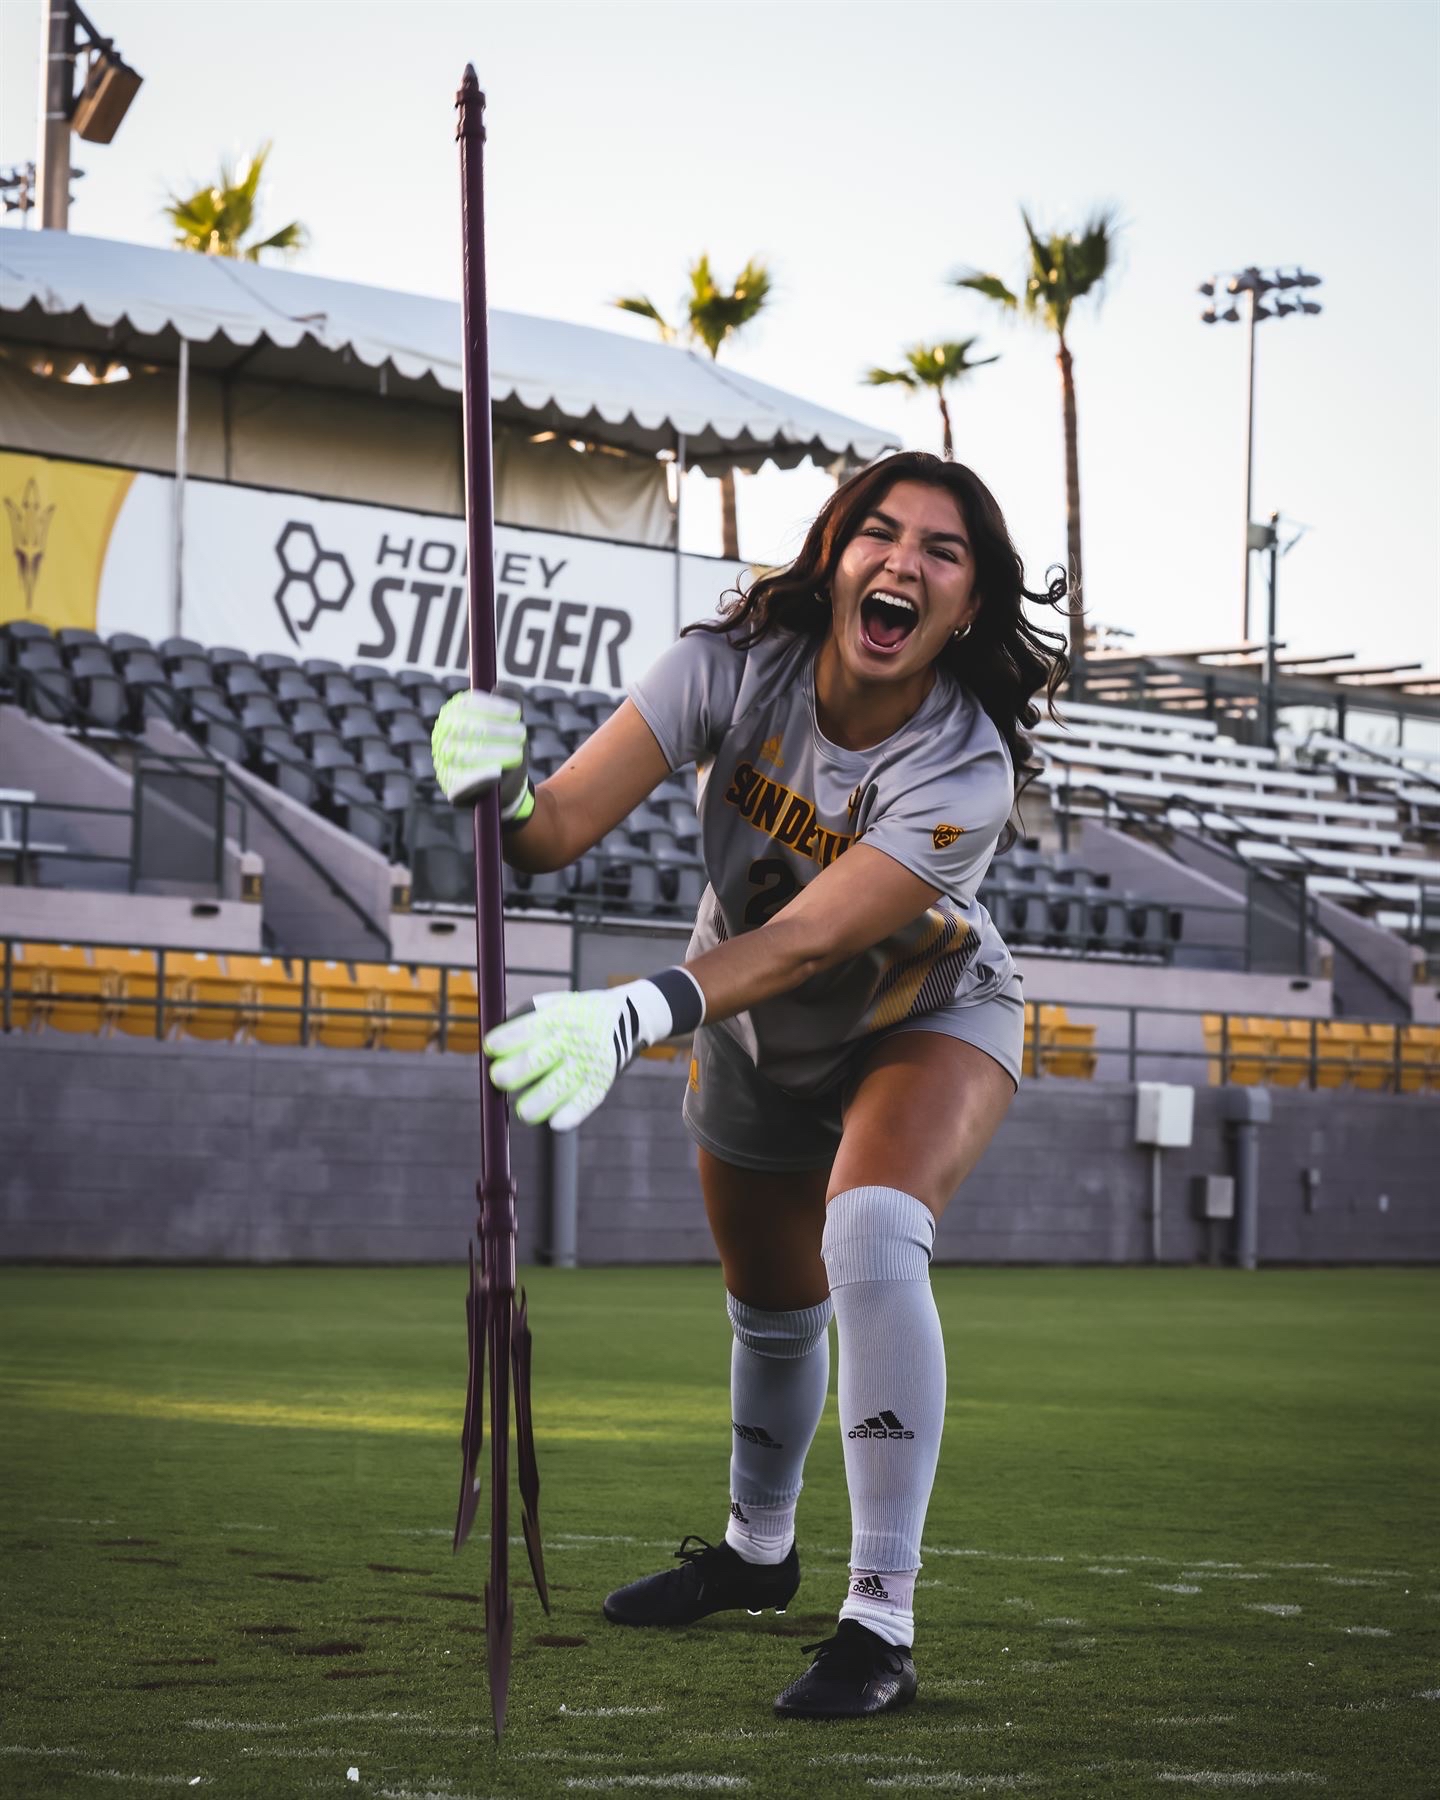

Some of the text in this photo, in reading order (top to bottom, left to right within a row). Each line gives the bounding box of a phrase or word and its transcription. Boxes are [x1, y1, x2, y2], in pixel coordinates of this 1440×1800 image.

[376, 534, 568, 588] HOEY
[847, 1427, 915, 1440] adidas
[852, 1583, 889, 1599] adidas
